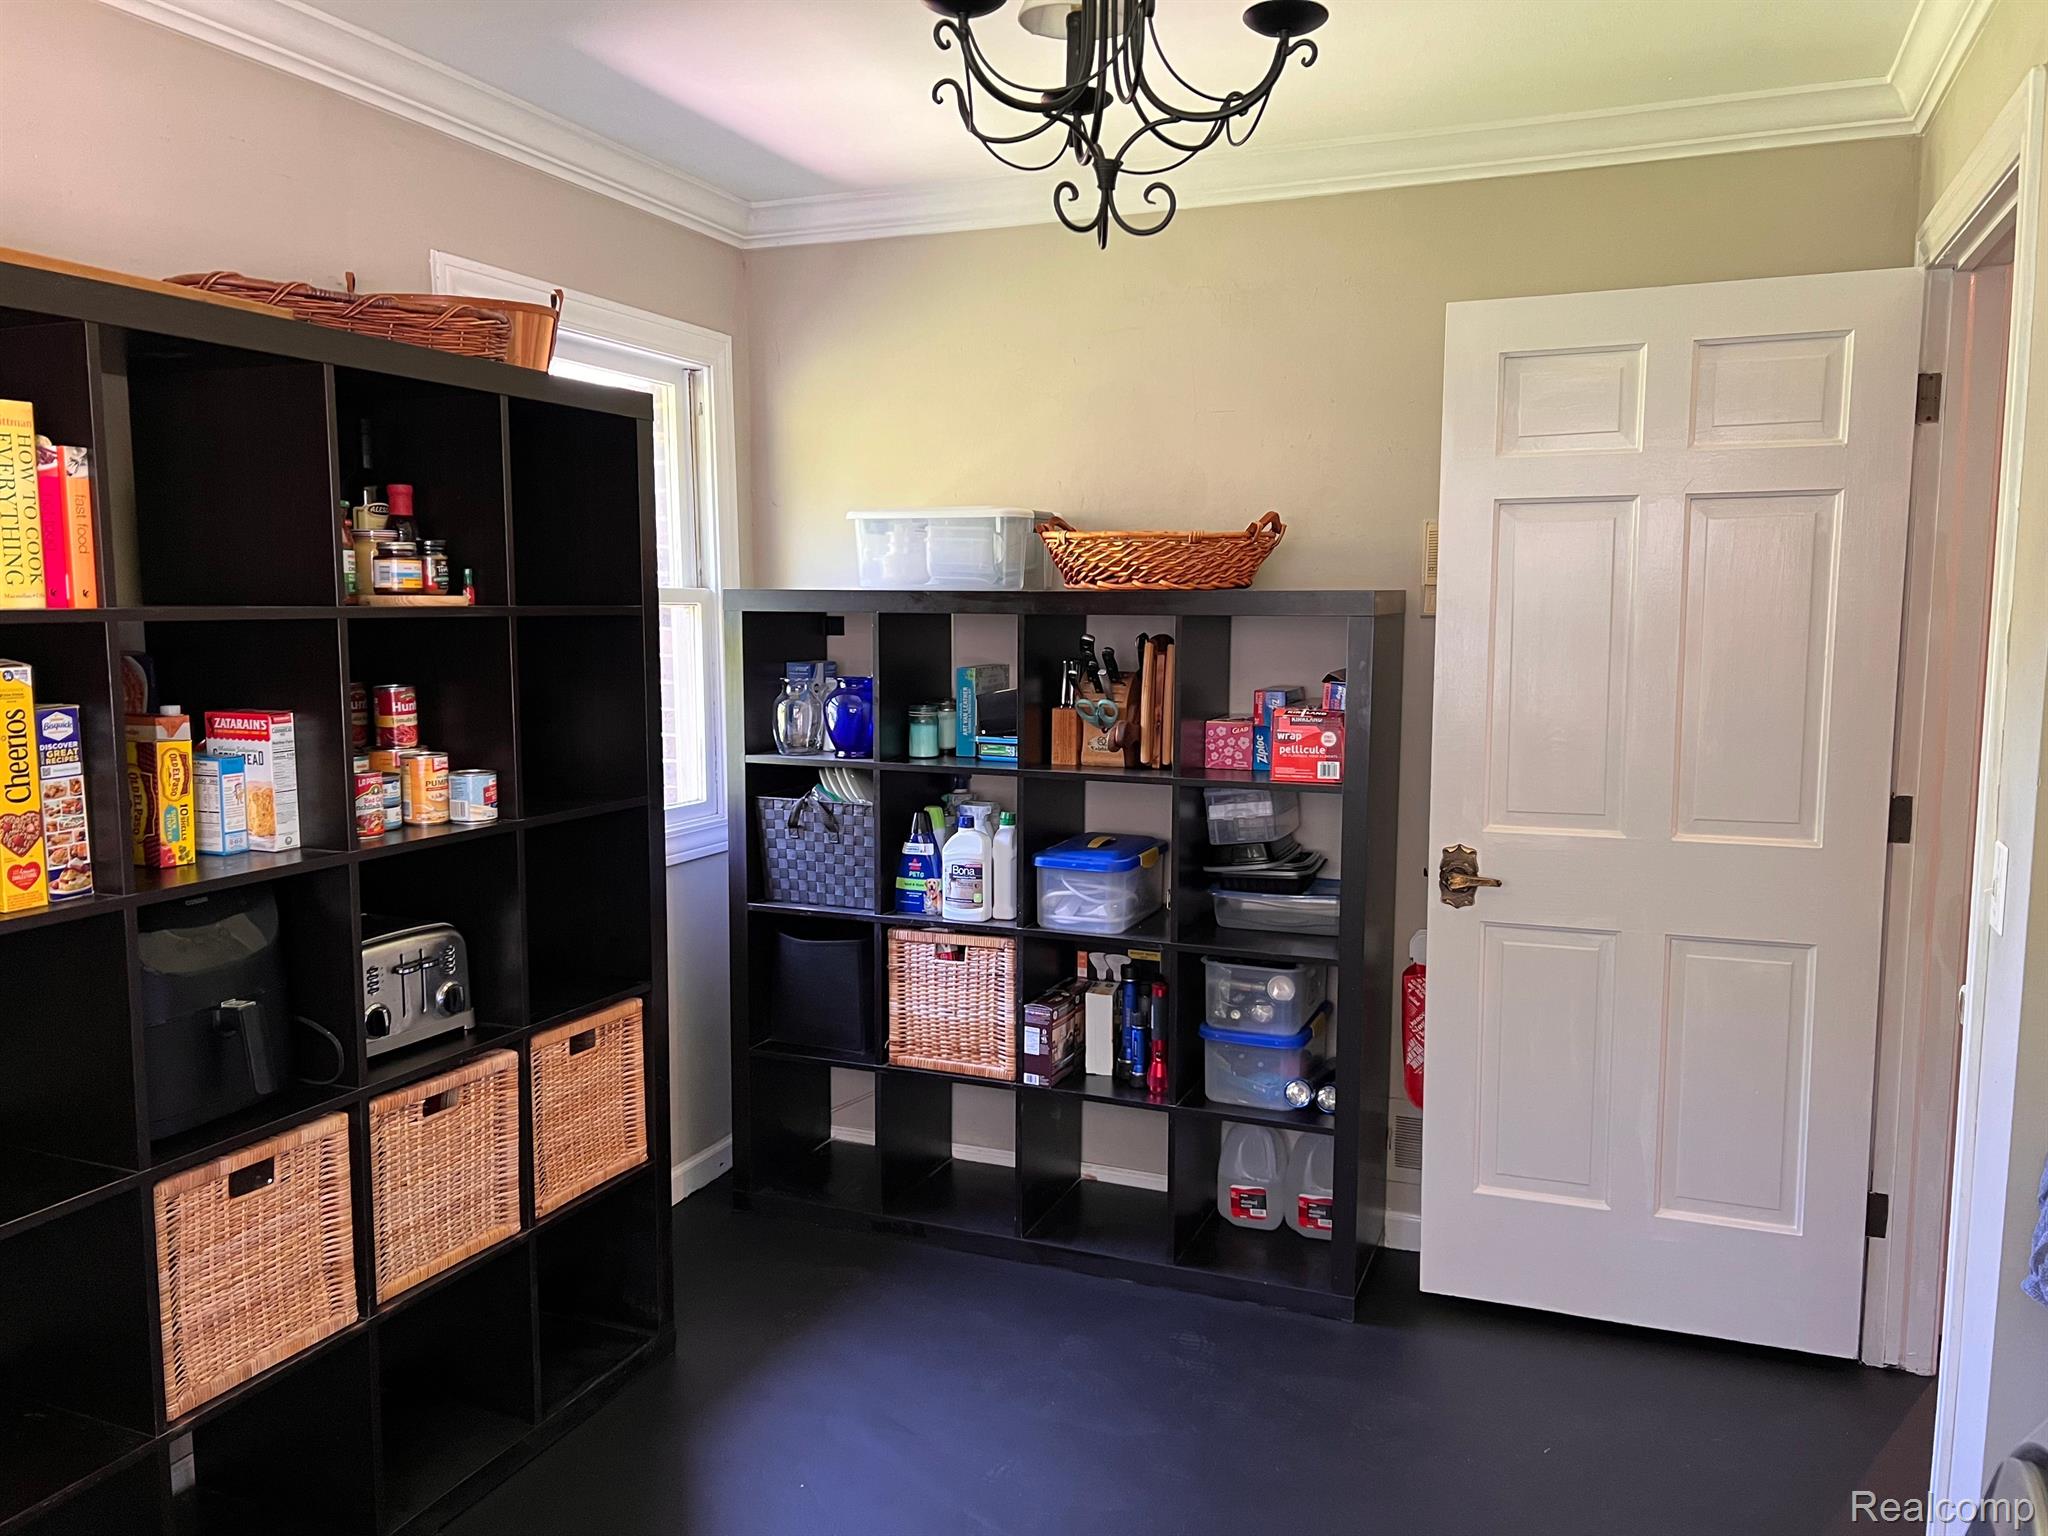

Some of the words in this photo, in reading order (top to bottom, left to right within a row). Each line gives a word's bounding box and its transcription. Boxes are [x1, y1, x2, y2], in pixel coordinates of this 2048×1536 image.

[17, 434, 35, 484] HOW
[0, 433, 25, 586] EVERYTHING
[23, 491, 38, 520] TO
[75, 494, 86, 519] fast
[77, 522, 90, 555] food
[25, 527, 43, 585] COOK
[43, 721, 72, 731] Bisquick
[213, 717, 268, 731] ZATARAIN'S
[1277, 732, 1302, 741] wrap
[39, 741, 78, 751] DISCOVER
[46, 748, 79, 758] GREAT
[1257, 734, 1269, 764] Ziploc
[1279, 745, 1326, 755] pellicule
[5, 708, 32, 804] Cheerios
[46, 755, 79, 765] RECIPES
[180, 803, 189, 816] 10
[952, 865, 975, 876] Bona
